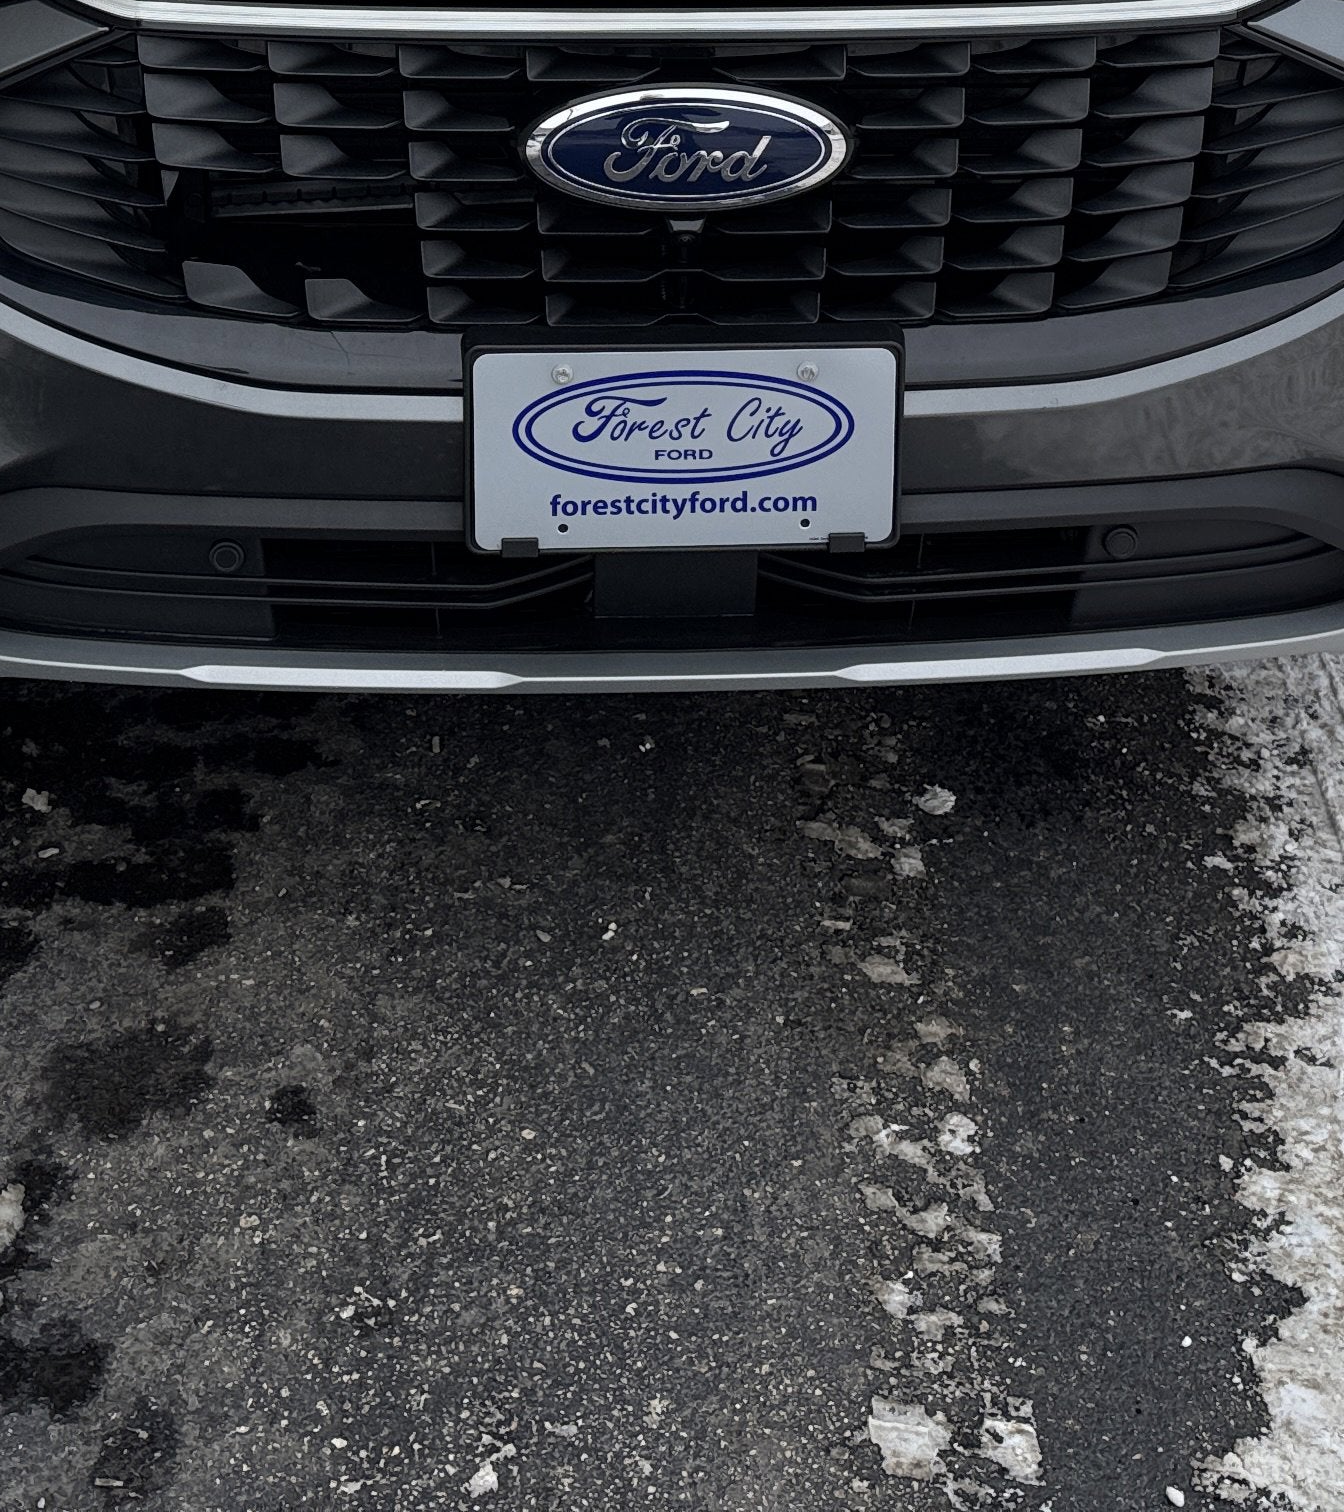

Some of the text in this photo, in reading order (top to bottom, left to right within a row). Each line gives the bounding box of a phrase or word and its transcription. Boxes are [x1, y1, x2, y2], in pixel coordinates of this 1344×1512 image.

[603, 117, 772, 183] Ford
[571, 395, 804, 458] Forest City
[653, 448, 714, 461] FORD
[549, 490, 818, 520] forestcityford.com
